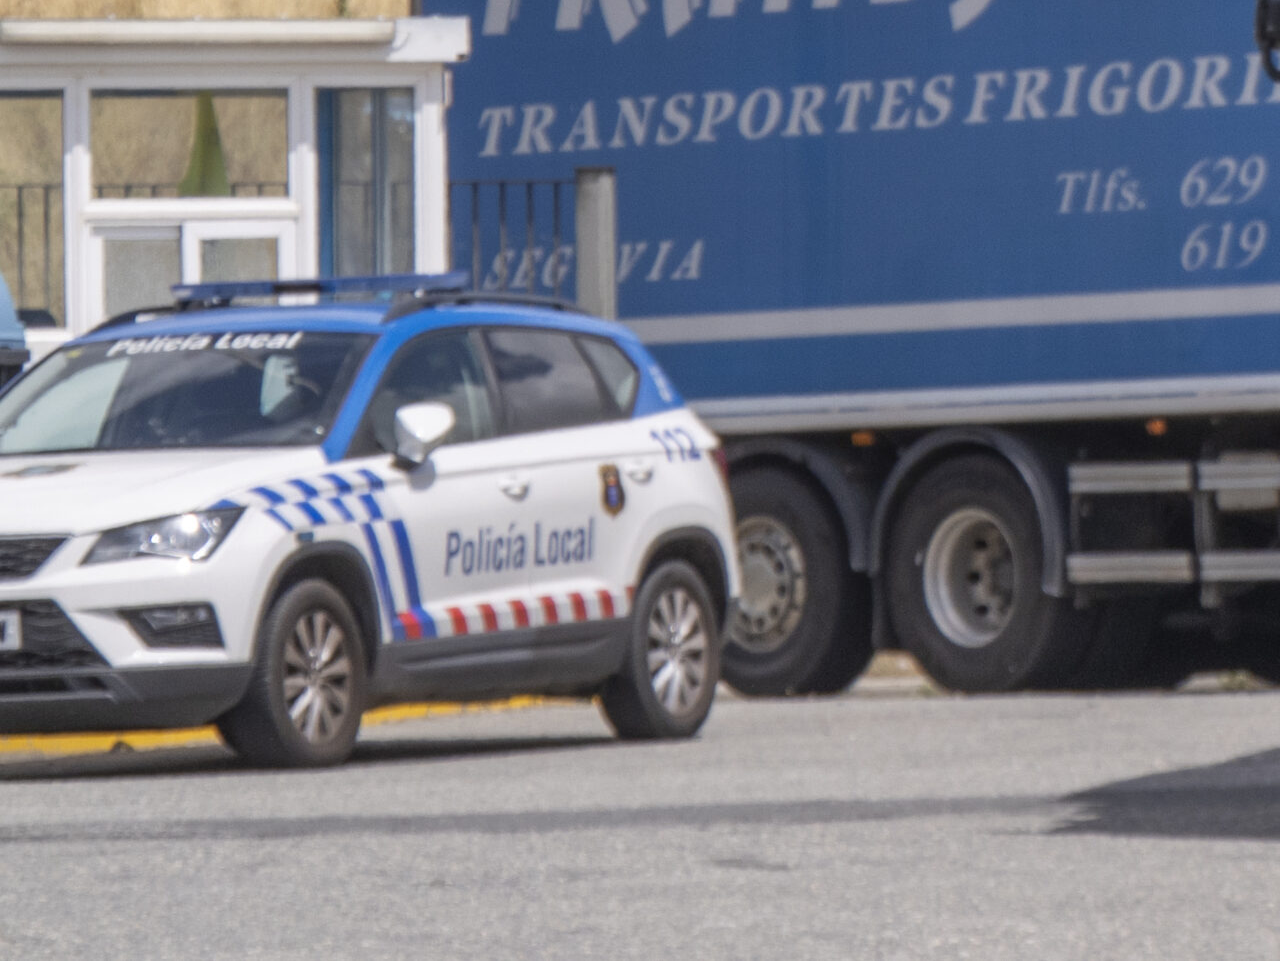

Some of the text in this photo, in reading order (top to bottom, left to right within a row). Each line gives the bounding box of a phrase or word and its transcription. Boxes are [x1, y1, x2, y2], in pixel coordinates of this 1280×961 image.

[478, 73, 954, 159] TRANSPORTES
[1056, 166, 1147, 215] Tlfs.
[1180, 153, 1268, 208] 629
[482, 238, 704, 292] SEGVIA
[1180, 219, 1268, 272] 619
[214, 330, 303, 350] Local
[650, 427, 701, 462] 112
[444, 515, 595, 577] Policía Local
